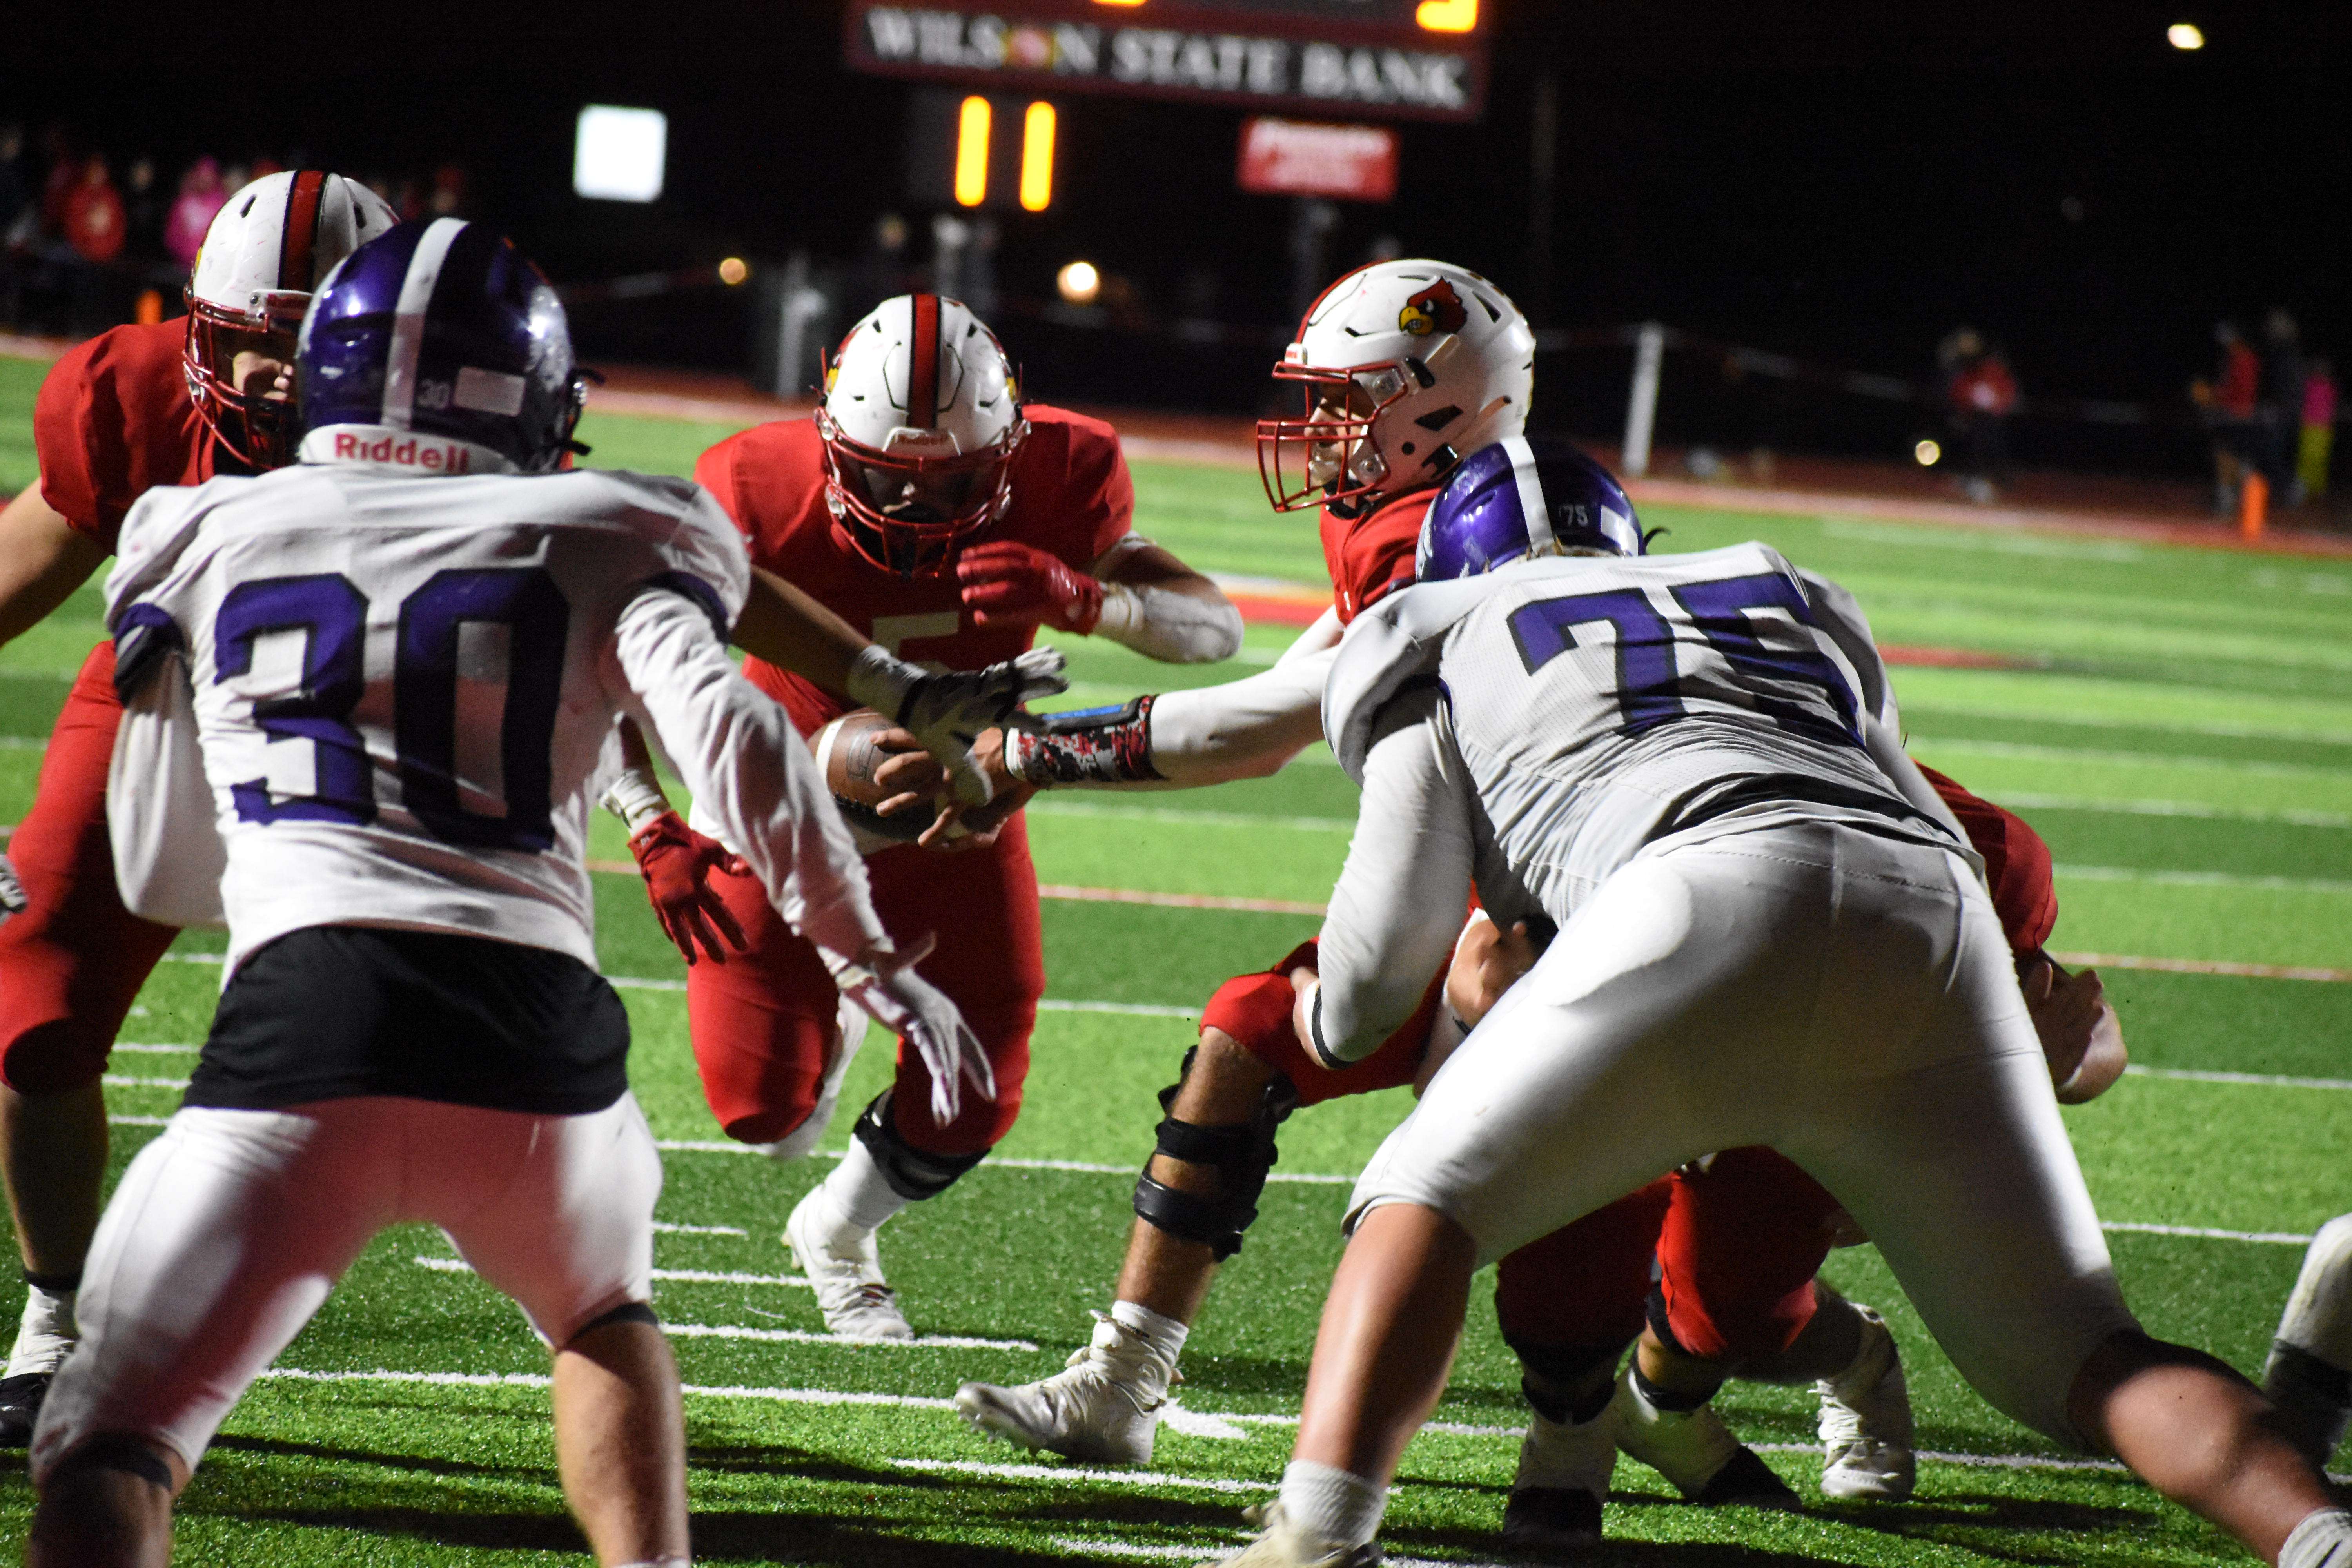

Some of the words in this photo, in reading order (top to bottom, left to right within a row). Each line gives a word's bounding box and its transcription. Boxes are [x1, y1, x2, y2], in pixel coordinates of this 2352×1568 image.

[1112, 28, 1290, 94] STATE
[1301, 42, 1468, 110] BANK
[418, 379, 451, 410] 30
[335, 433, 470, 472] Riddell
[1559, 503, 1589, 527] 75
[1507, 572, 1868, 751] 75
[214, 567, 570, 854] 30
